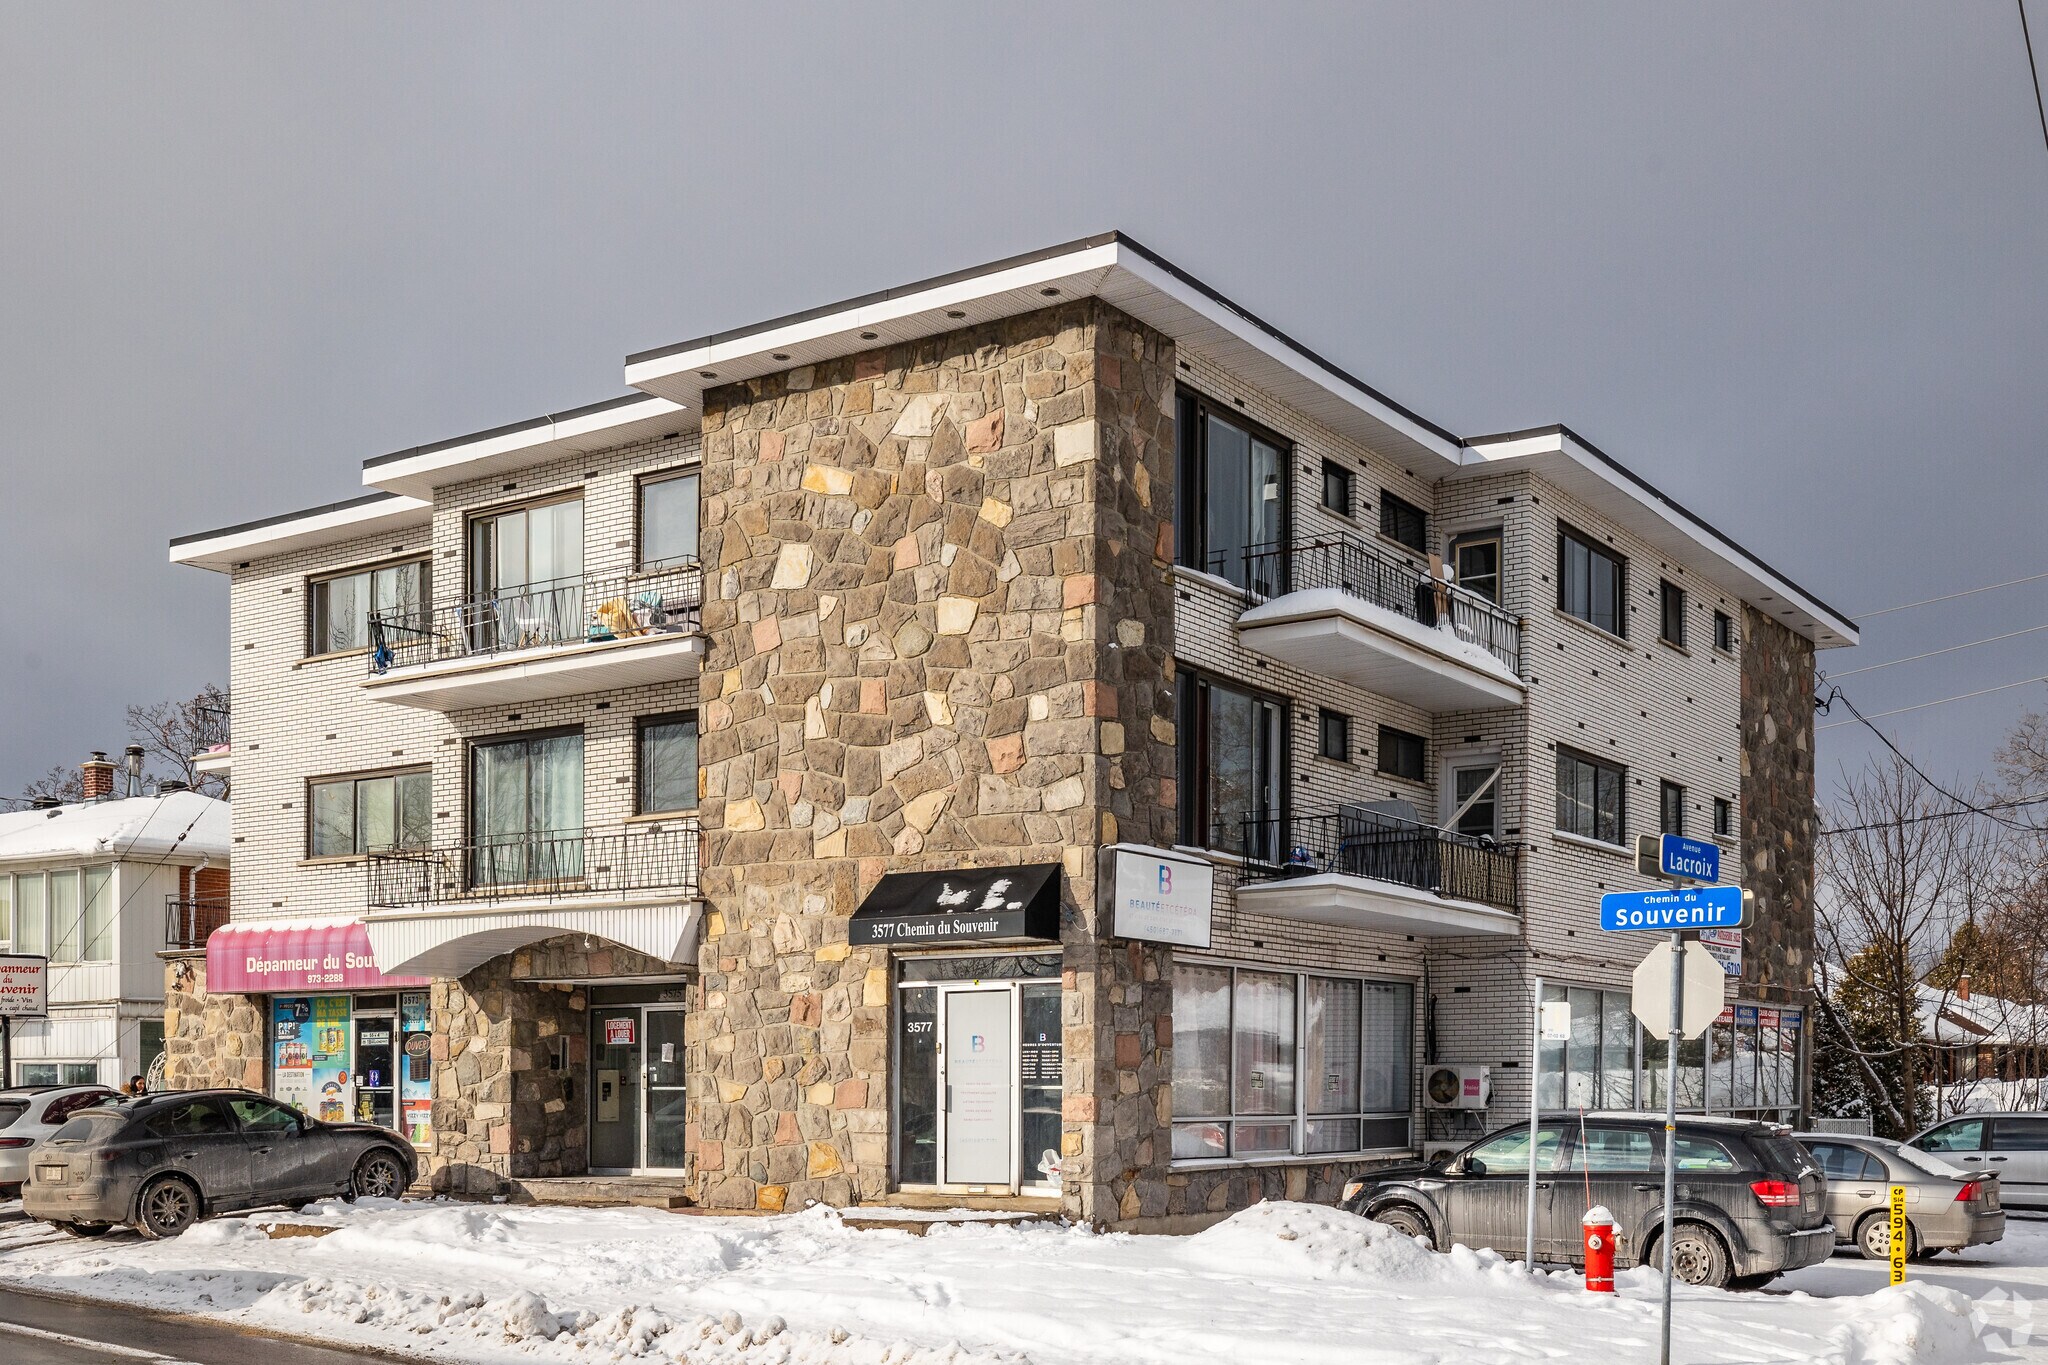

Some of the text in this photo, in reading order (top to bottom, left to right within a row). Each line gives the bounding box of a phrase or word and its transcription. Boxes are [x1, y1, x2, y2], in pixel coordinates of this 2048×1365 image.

[1682, 843, 1701, 854] Avenue
[1670, 852, 1713, 877] Lacroix
[1644, 894, 1697, 904] Chemin du
[1615, 902, 1726, 926] Souvenir
[872, 917, 999, 938] 3577 Chemin du Souvenir
[246, 952, 380, 975] Dépanneur du Souv
[0, 965, 41, 973] anneur
[3, 974, 13, 983] du
[307, 973, 343, 983] 973-2288
[404, 996, 418, 1005] 3573
[1714, 1015, 1733, 1023] ATEAUX
[608, 1021, 632, 1030] LOGEMENT
[907, 1021, 933, 1033] 3577
[615, 1030, 630, 1038] LOUER
[407, 1039, 430, 1051] OUVERT
